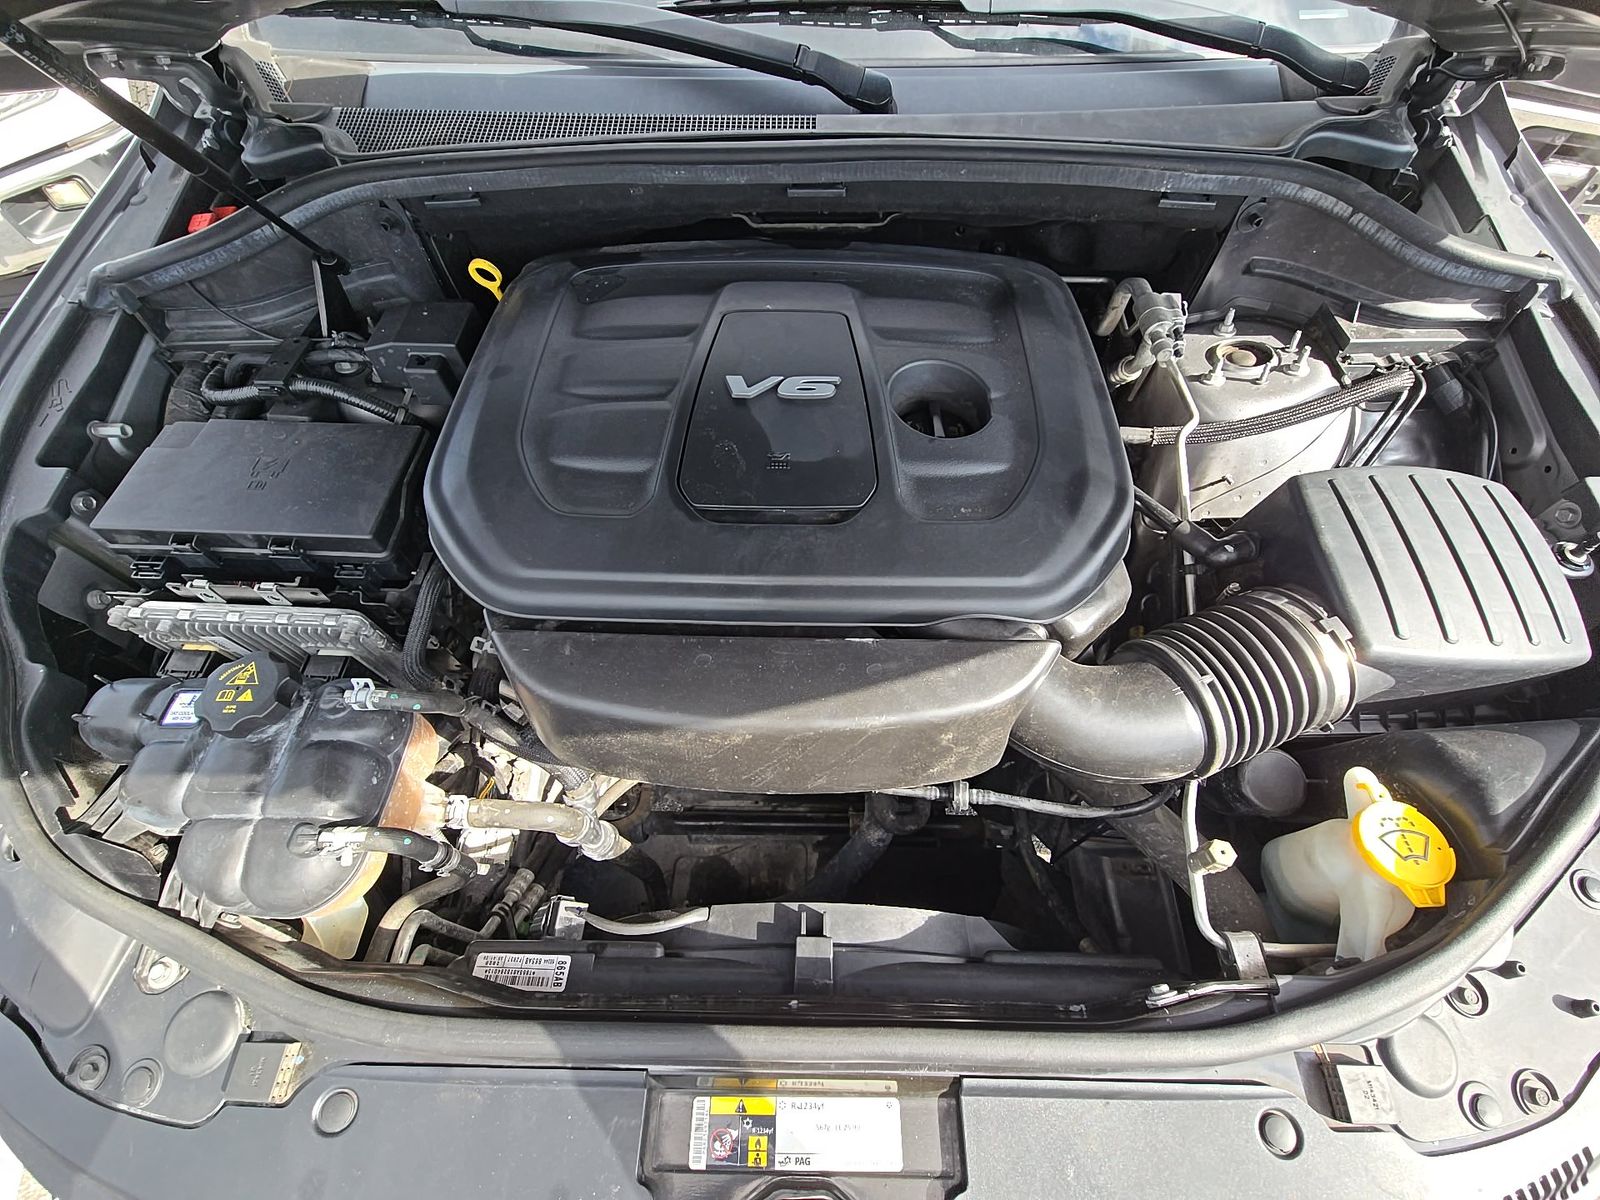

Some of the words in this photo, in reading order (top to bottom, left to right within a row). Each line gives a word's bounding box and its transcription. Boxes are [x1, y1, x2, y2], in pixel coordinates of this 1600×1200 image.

[22, 49, 78, 88] STABILUS
[725, 374, 842, 399] V6
[552, 960, 567, 988] 865AB
[794, 1157, 811, 1166] PAG
